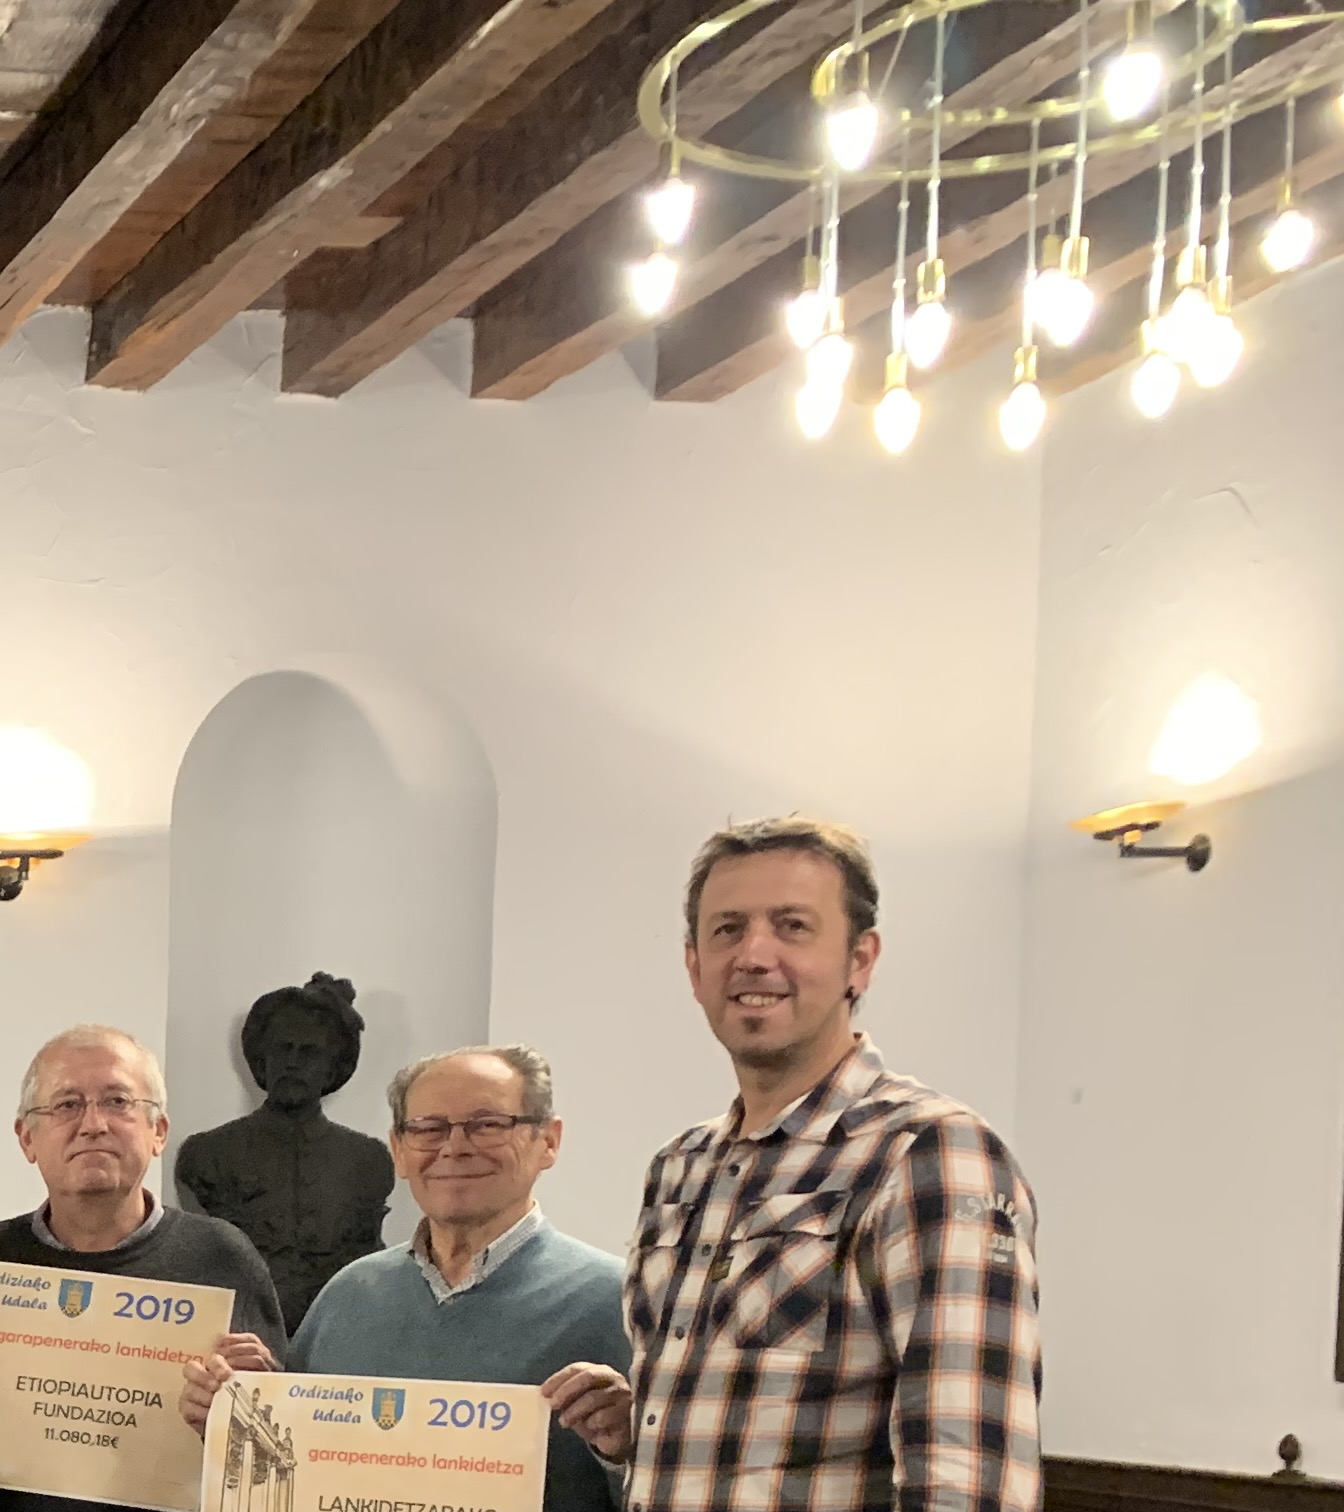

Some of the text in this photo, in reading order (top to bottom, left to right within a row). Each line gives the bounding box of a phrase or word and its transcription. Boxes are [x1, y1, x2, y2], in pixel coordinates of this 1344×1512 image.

[1, 1295, 47, 1311] Udala
[114, 1292, 195, 1325] 2019
[16, 1376, 163, 1409] ETIOPIAUTOPIA
[289, 1384, 363, 1403] Ordiziako
[33, 1402, 137, 1428] FUNDAZIOA
[313, 1409, 361, 1424] Udala
[427, 1398, 511, 1431] 2019
[308, 1448, 524, 1475] garapenerako lankidetza
